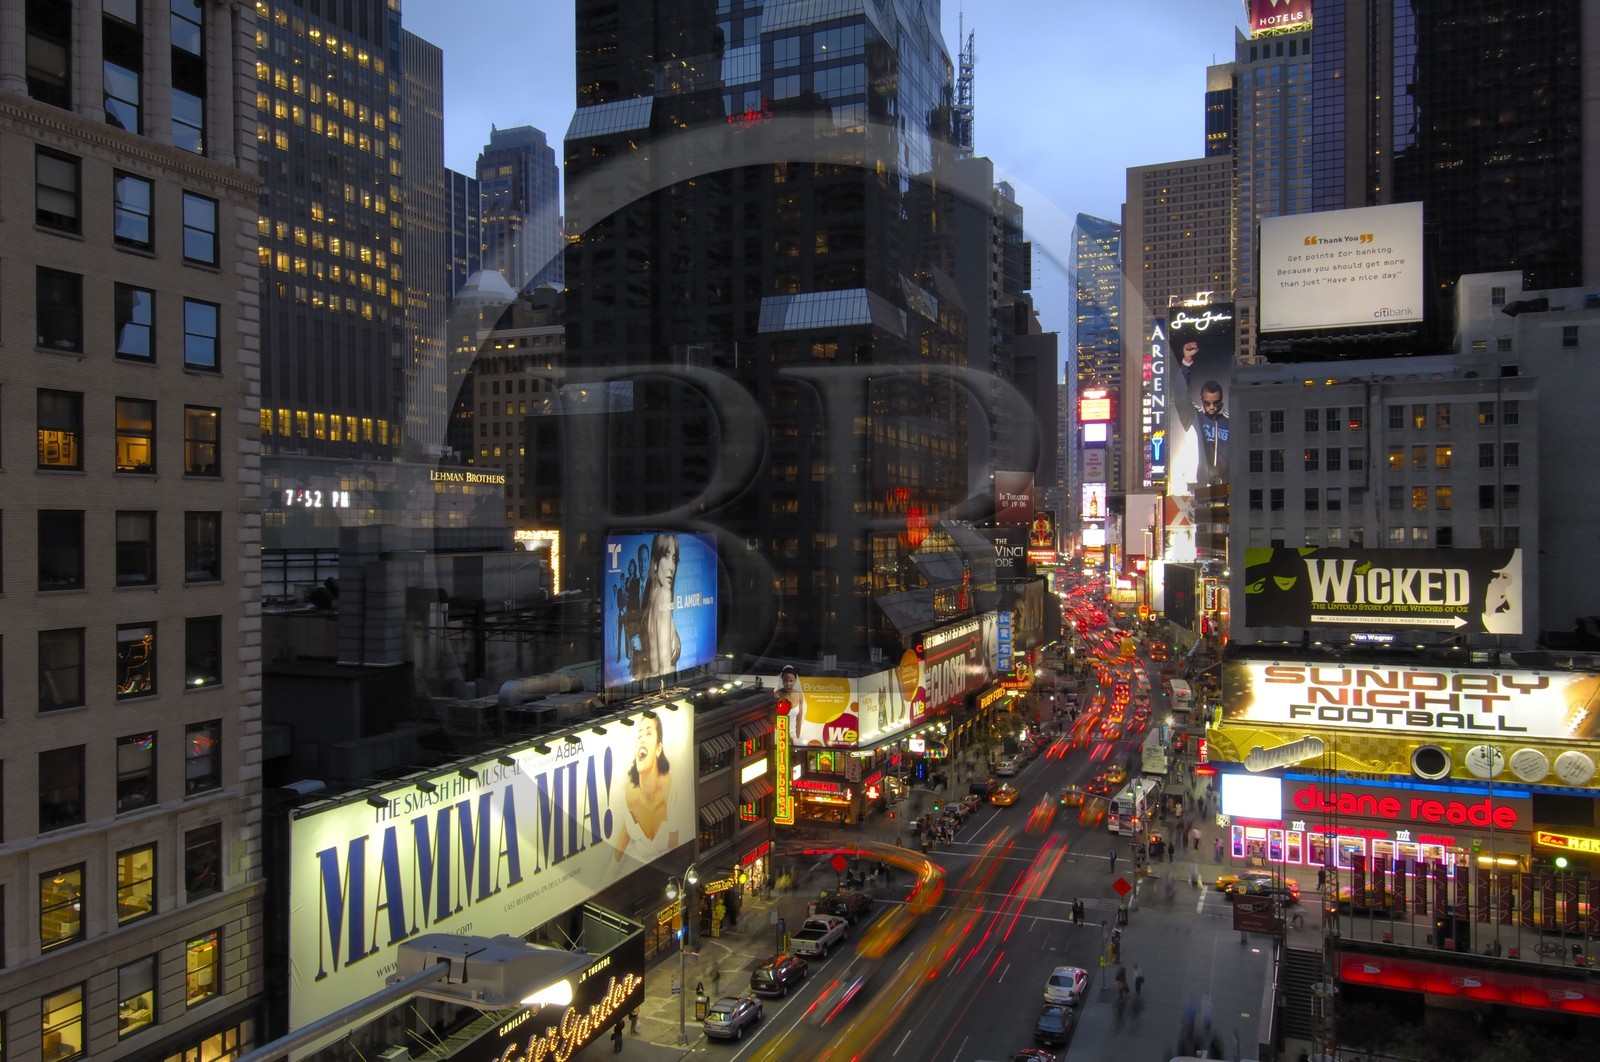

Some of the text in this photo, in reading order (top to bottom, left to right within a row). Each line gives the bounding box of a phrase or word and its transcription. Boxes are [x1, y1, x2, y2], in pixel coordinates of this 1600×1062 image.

[1260, 11, 1303, 26] HOTELS
[1287, 246, 1394, 262] Get points for banking.
[1277, 258, 1405, 276] Because you should get more
[1280, 280, 1300, 288] than
[1302, 278, 1320, 287] just
[1358, 273, 1378, 281] nice
[1374, 306, 1413, 318] citibank
[1151, 325, 1164, 424] ARGENT
[430, 470, 505, 485] LEHMAN BROTHERS
[286, 489, 349, 508] 7:52 PM
[1000, 492, 1030, 500] IN THEATERS
[994, 546, 1024, 557] VINCI
[995, 558, 1014, 567] ODE
[1304, 558, 1470, 606] WICKED
[676, 595, 683, 609] EL
[684, 593, 700, 608] AMOR
[1312, 602, 1326, 610] THE
[1328, 603, 1358, 611] UNTOLD
[1358, 604, 1382, 612] STORY
[1383, 604, 1394, 612] OF
[1409, 604, 1444, 613] WITCHES
[1368, 634, 1394, 642] Wagner
[804, 684, 844, 692] Bridezillas
[931, 654, 966, 709] CLOSER
[1265, 666, 1549, 694] SUNDAY
[912, 700, 925, 716] We
[980, 694, 994, 710] RUBY
[1308, 686, 1510, 713] NIGHT
[1290, 705, 1527, 732] FOOTBALL
[828, 726, 858, 742] We
[555, 740, 584, 762] ABBA
[404, 781, 450, 814] SMASH
[475, 758, 522, 788] MUSICAL
[1294, 784, 1518, 828] duane reade
[316, 746, 614, 982] MAMMA MIA!
[504, 900, 516, 912] CAST
[516, 888, 540, 907] RECORDING
[540, 884, 548, 894] ON
[548, 878, 562, 890] DECCA
[500, 956, 610, 1037] CADILLAC THEATRE
[554, 973, 642, 1062] Garden
